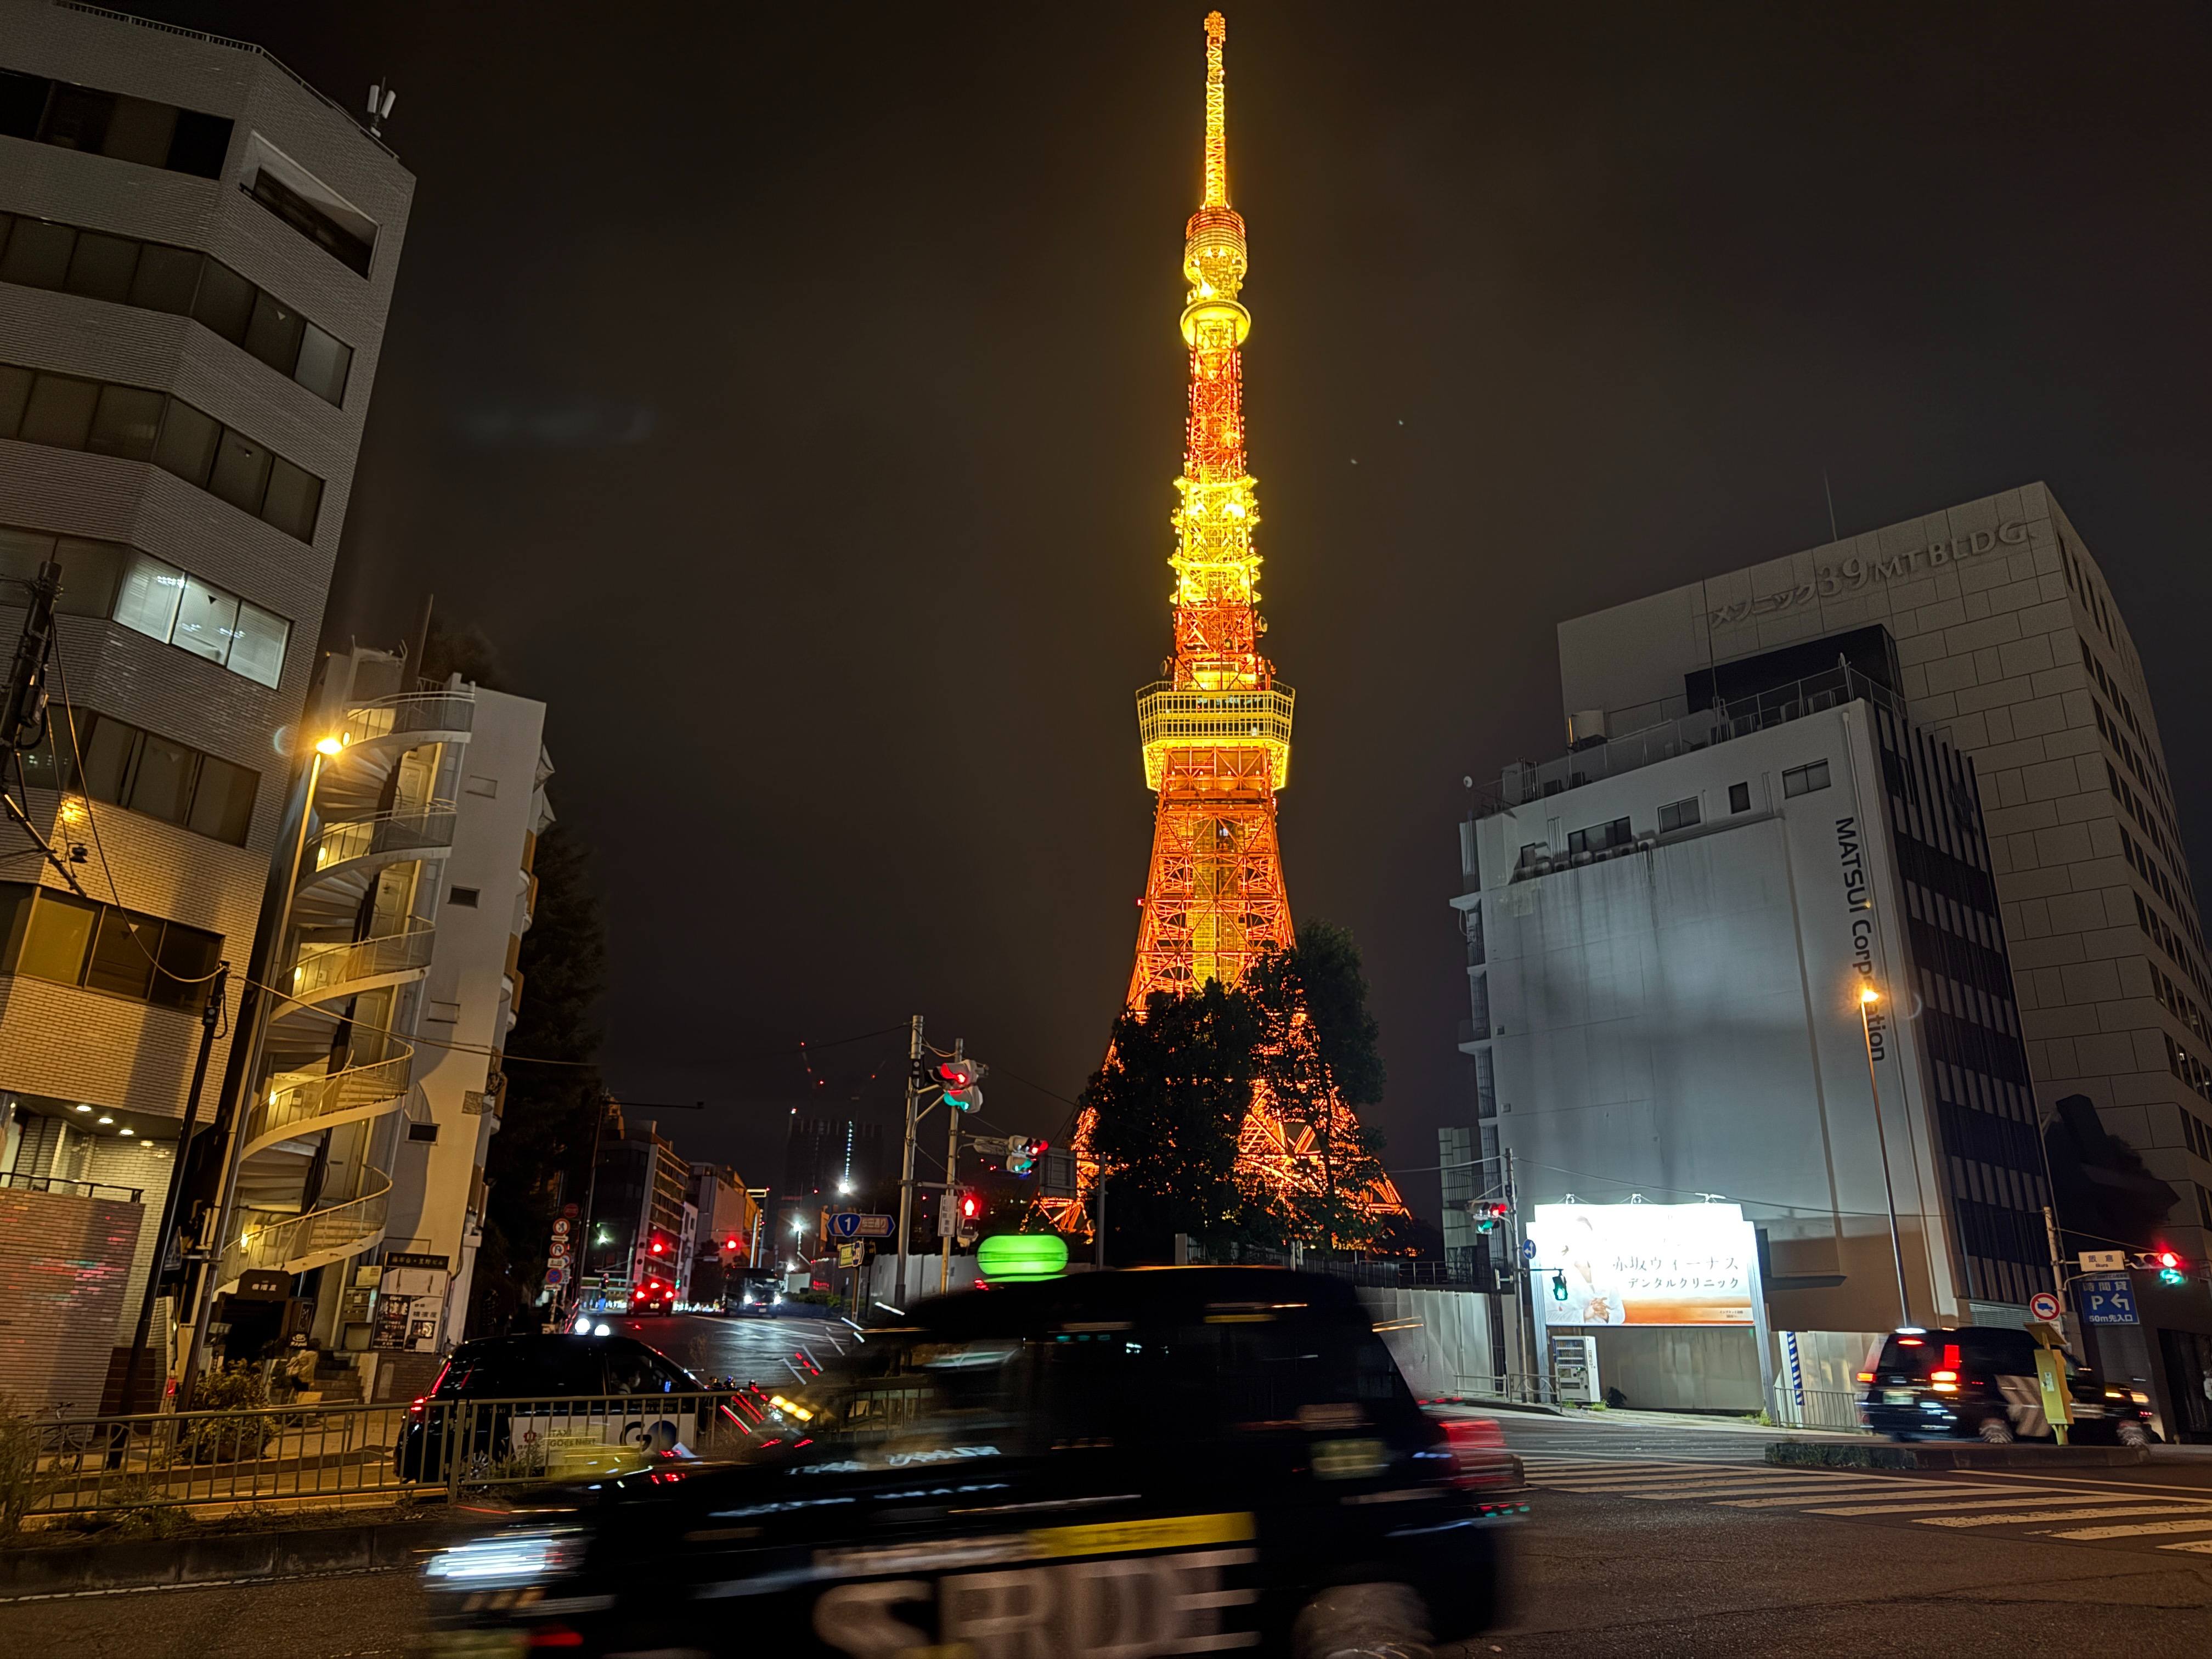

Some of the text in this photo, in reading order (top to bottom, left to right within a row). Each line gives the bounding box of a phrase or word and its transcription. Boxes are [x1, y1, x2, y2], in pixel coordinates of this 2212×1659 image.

[1836, 817, 1886, 1062] MATSUI Corpation
[844, 1217, 851, 1232] 1
[1628, 1277, 1739, 1288] デンタルクリニック
[2083, 1280, 2128, 1292] 時間貸
[2091, 1295, 2104, 1310] P
[2089, 1314, 2133, 1323] 50m先入口
